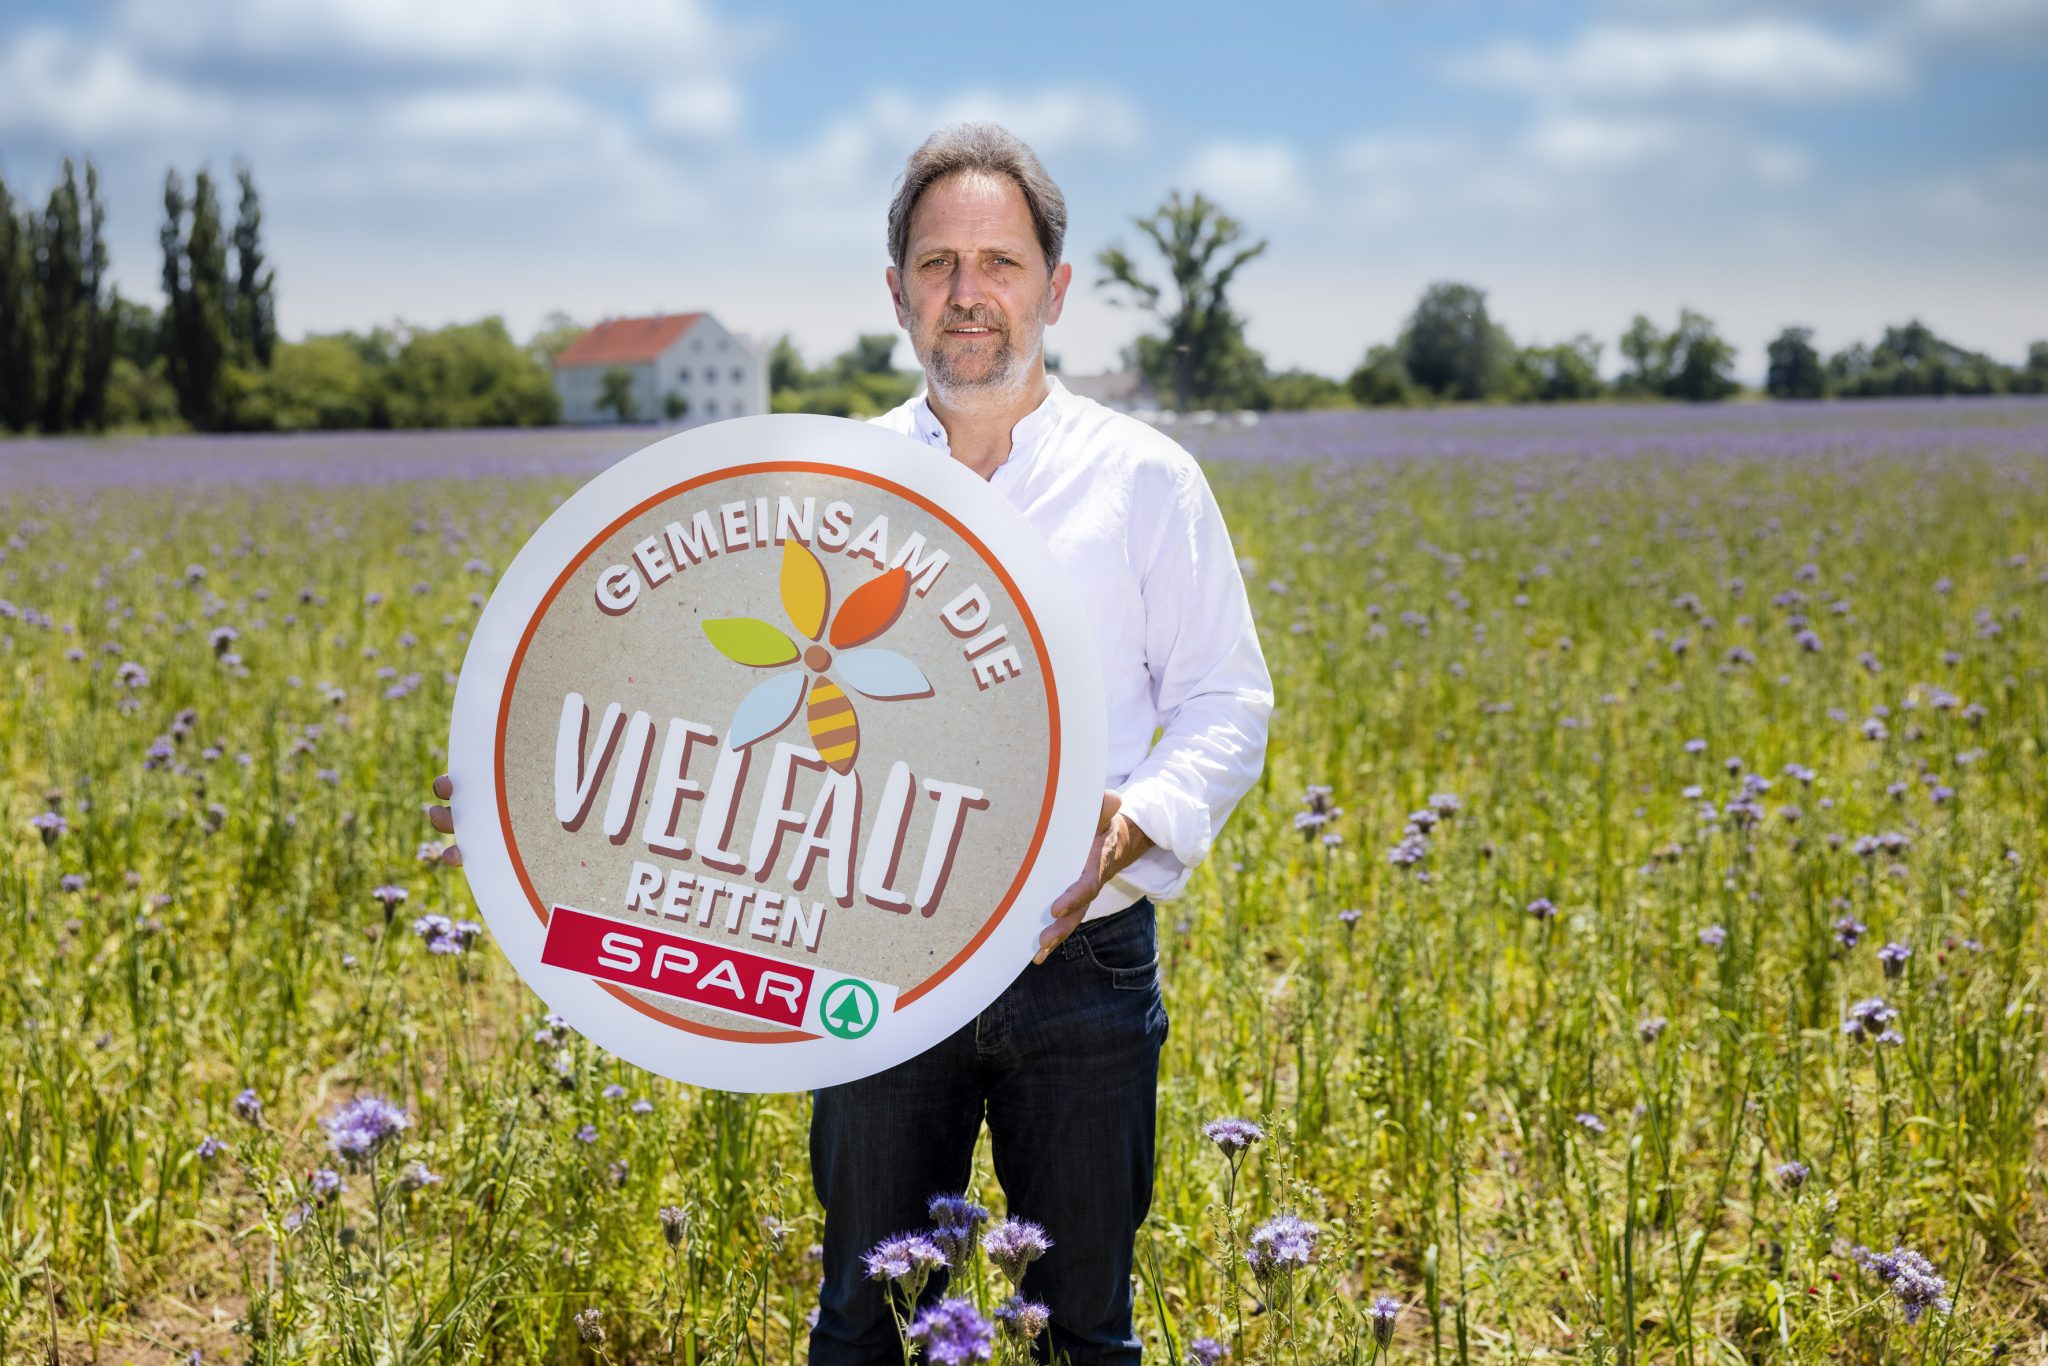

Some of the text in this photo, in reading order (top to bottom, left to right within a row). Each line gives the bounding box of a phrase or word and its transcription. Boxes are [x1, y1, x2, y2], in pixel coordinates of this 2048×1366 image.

[595, 496, 1022, 690] GEMEINSAM DIE
[555, 693, 988, 916] VIELFALT
[597, 932, 804, 1013] SPAR
[626, 863, 826, 952] RETTEN
